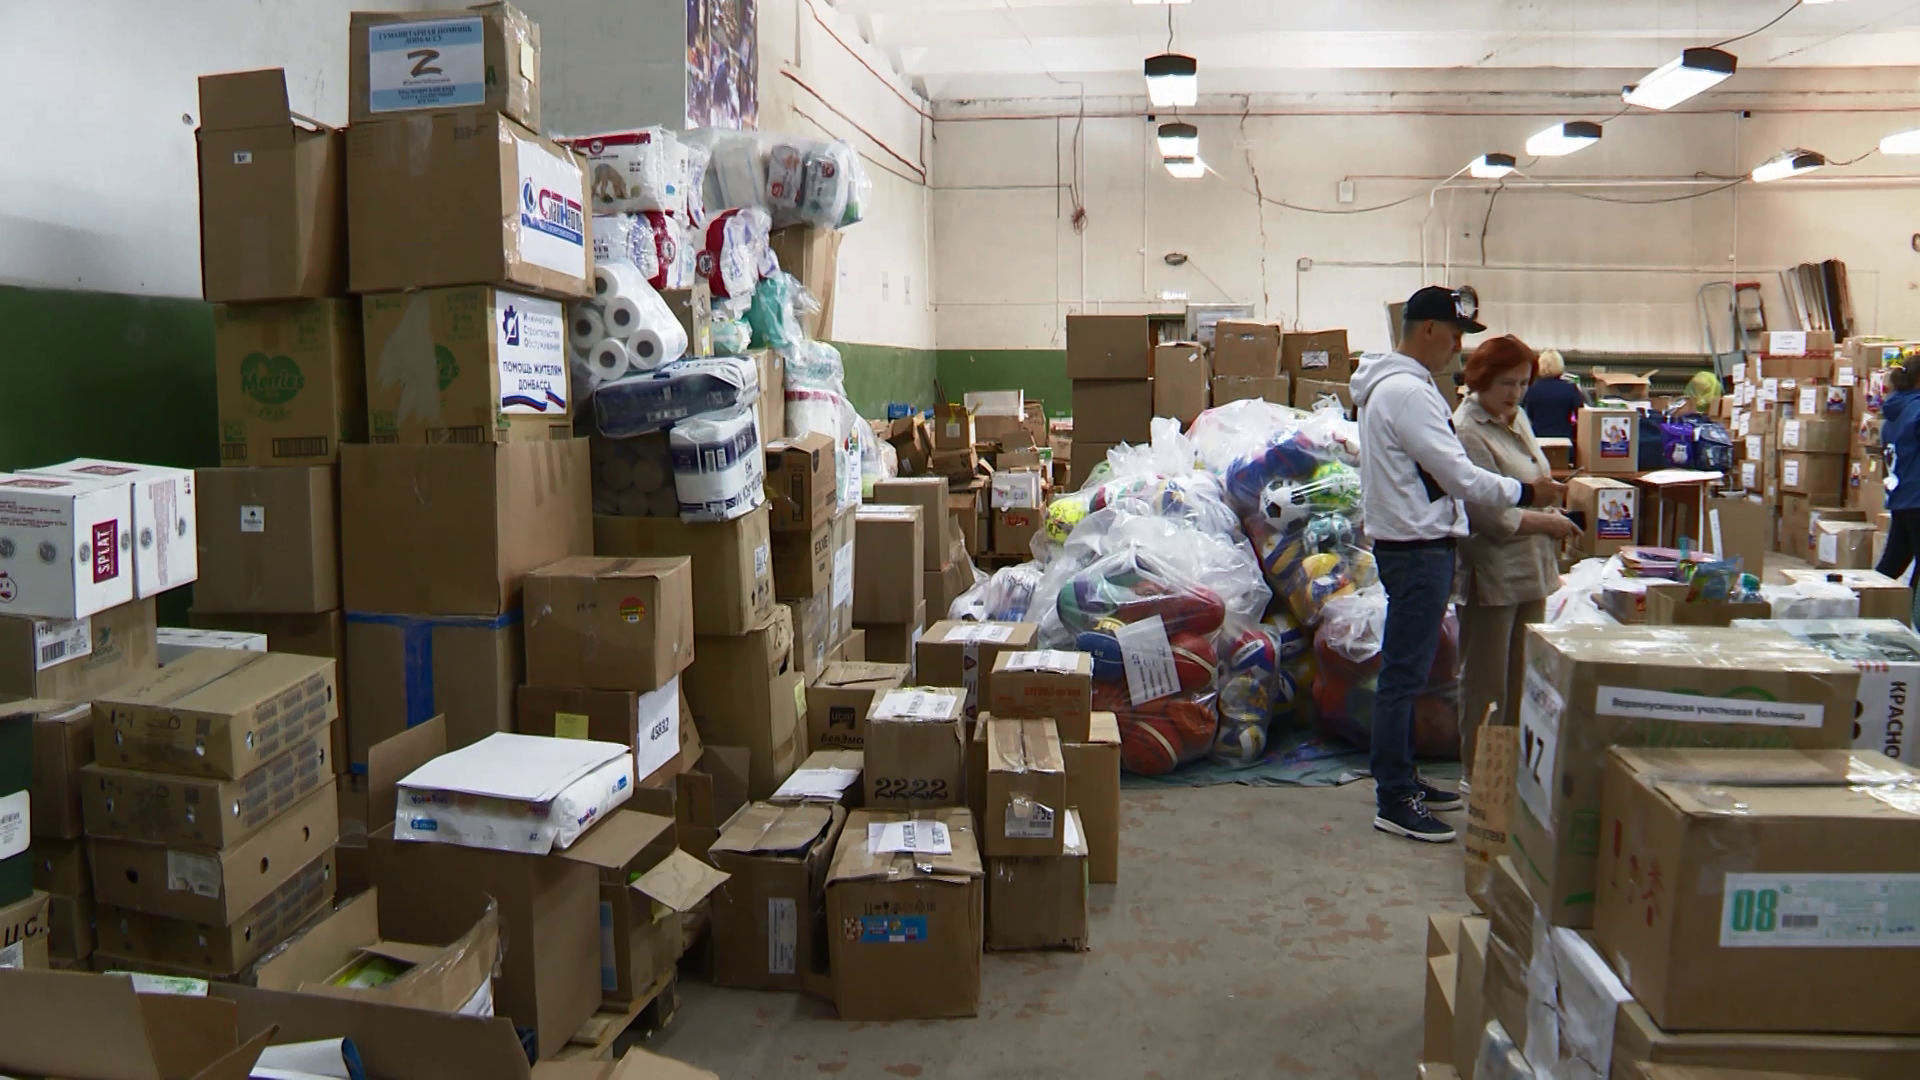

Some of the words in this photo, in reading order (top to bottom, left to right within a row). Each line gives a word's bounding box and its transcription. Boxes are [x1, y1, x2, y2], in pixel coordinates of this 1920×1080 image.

[407, 49, 444, 78] Z
[503, 361, 533, 375] ПОМОЩЬ
[534, 363, 562, 377] ЖИТЕЛЯМ
[518, 378, 552, 391] ДОНБАССА
[97, 530, 111, 575] SPLAT
[1755, 707, 1806, 721] больница
[874, 777, 949, 800] 2222
[1732, 888, 1779, 933] 08
